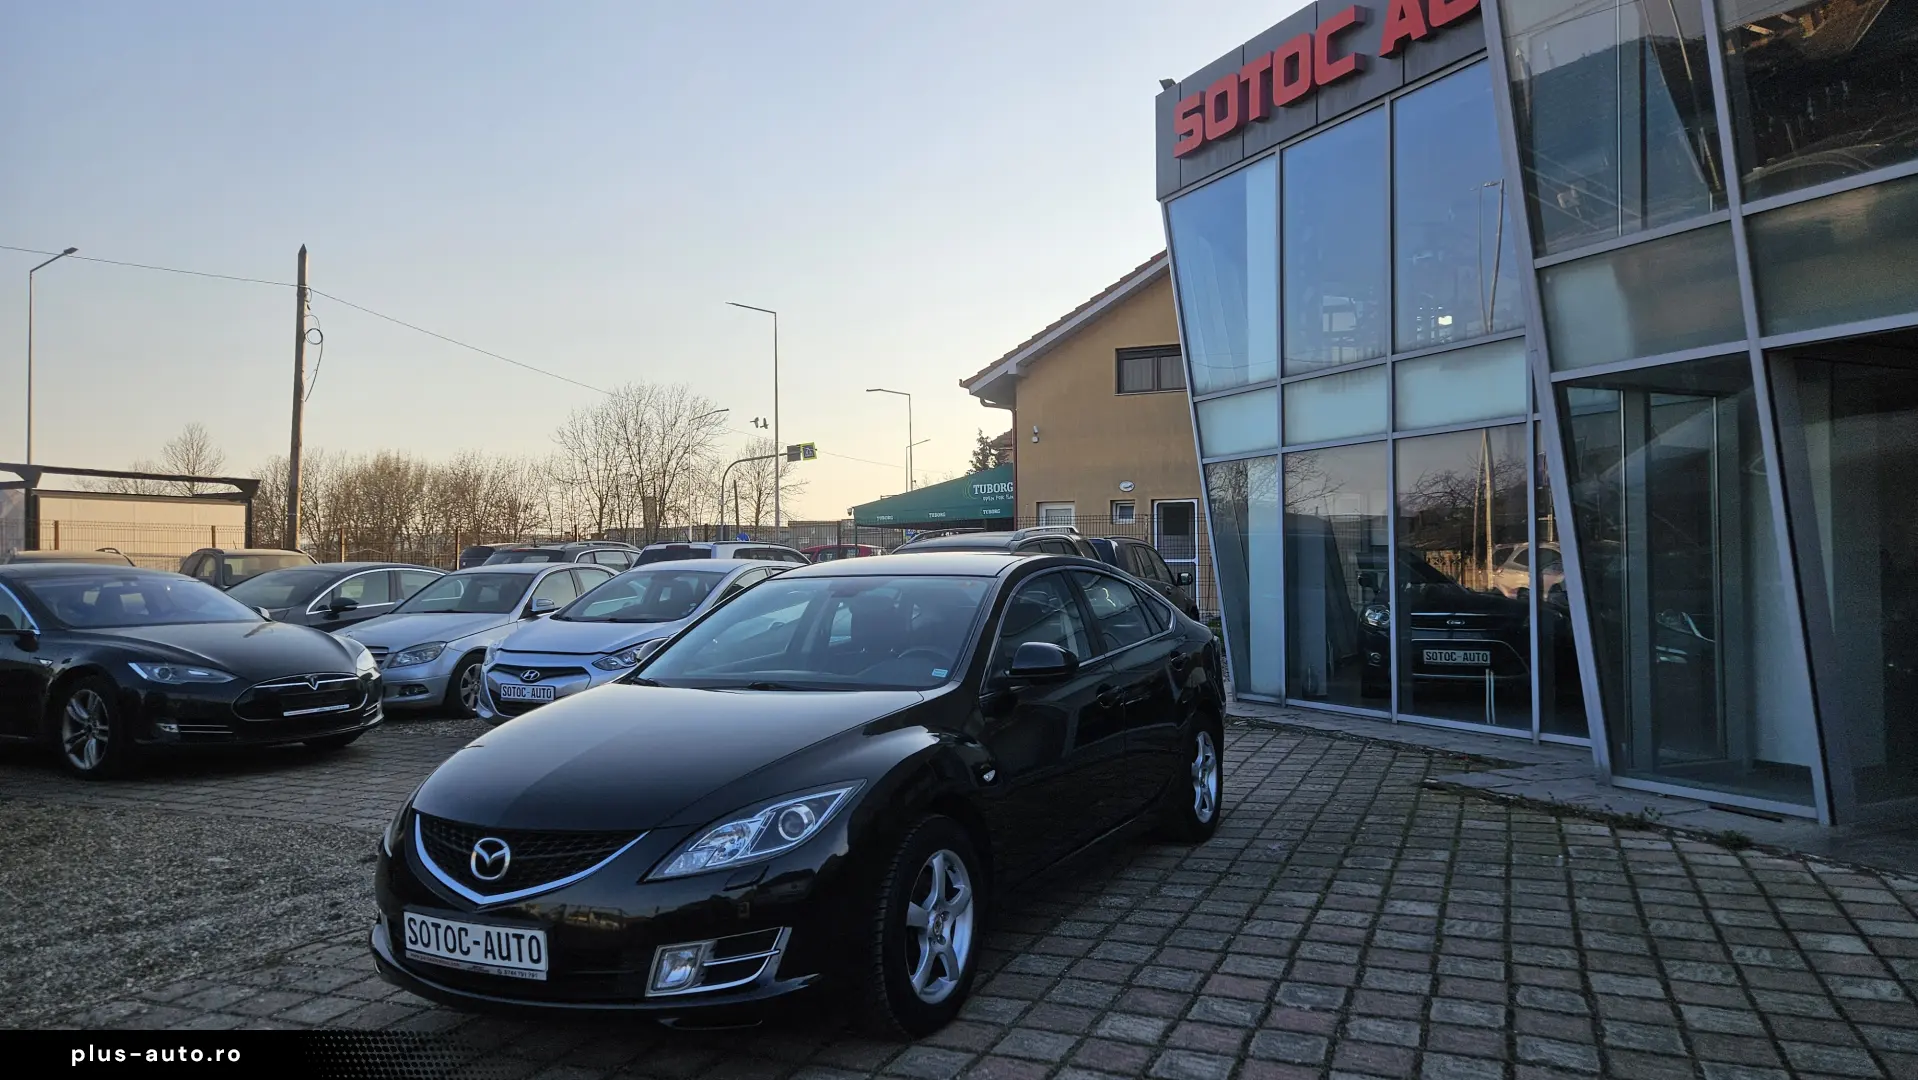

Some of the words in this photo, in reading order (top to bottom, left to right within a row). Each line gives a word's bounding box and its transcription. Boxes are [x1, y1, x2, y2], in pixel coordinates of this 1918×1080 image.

[1174, 4, 1364, 158] SOTOC
[972, 482, 1014, 495] TUBORG
[1426, 651, 1488, 662] SOTOC-AUTO
[502, 686, 552, 699] SOTOC-AUTO
[407, 917, 542, 964] SOTOC-AUTO
